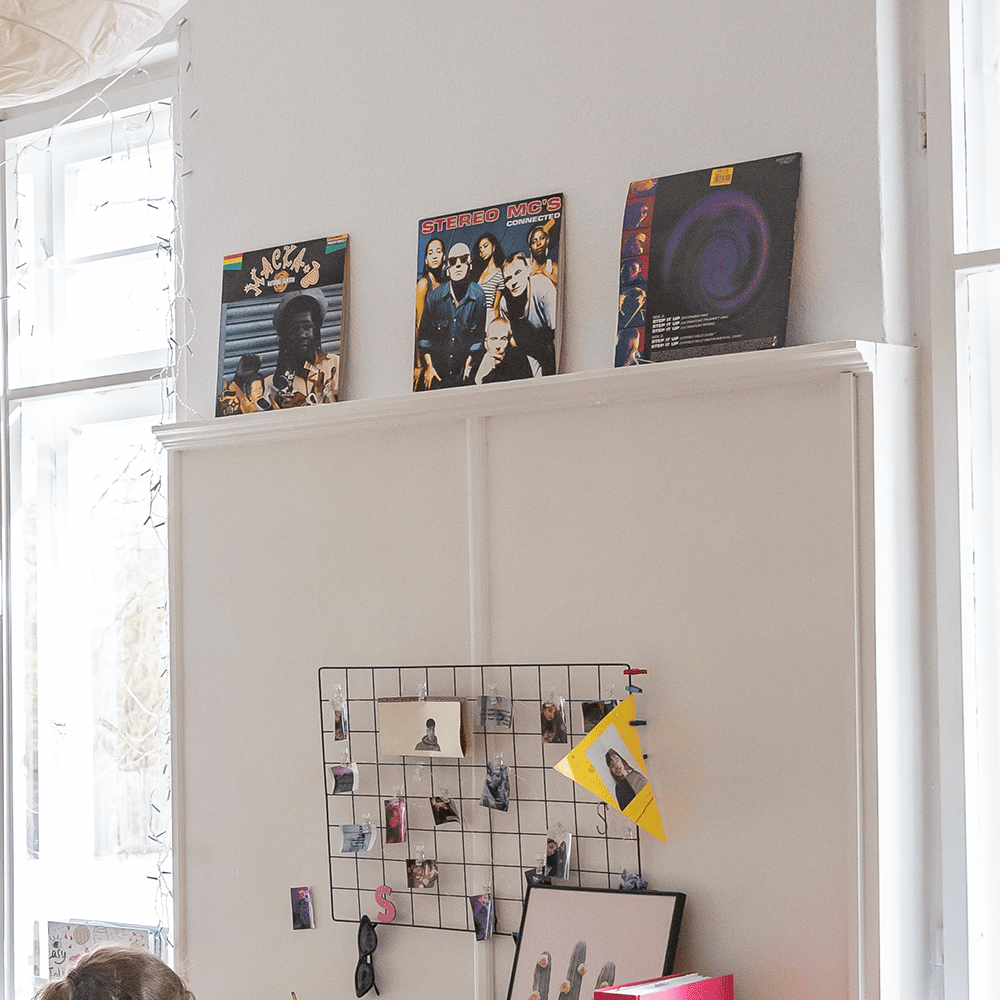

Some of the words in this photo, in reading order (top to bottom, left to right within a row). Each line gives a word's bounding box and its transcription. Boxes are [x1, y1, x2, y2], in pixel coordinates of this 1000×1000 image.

[421, 208, 500, 234] STEREO
[507, 197, 562, 219] MC'S
[506, 212, 561, 227] CONNECTED
[375, 885, 396, 923] S
